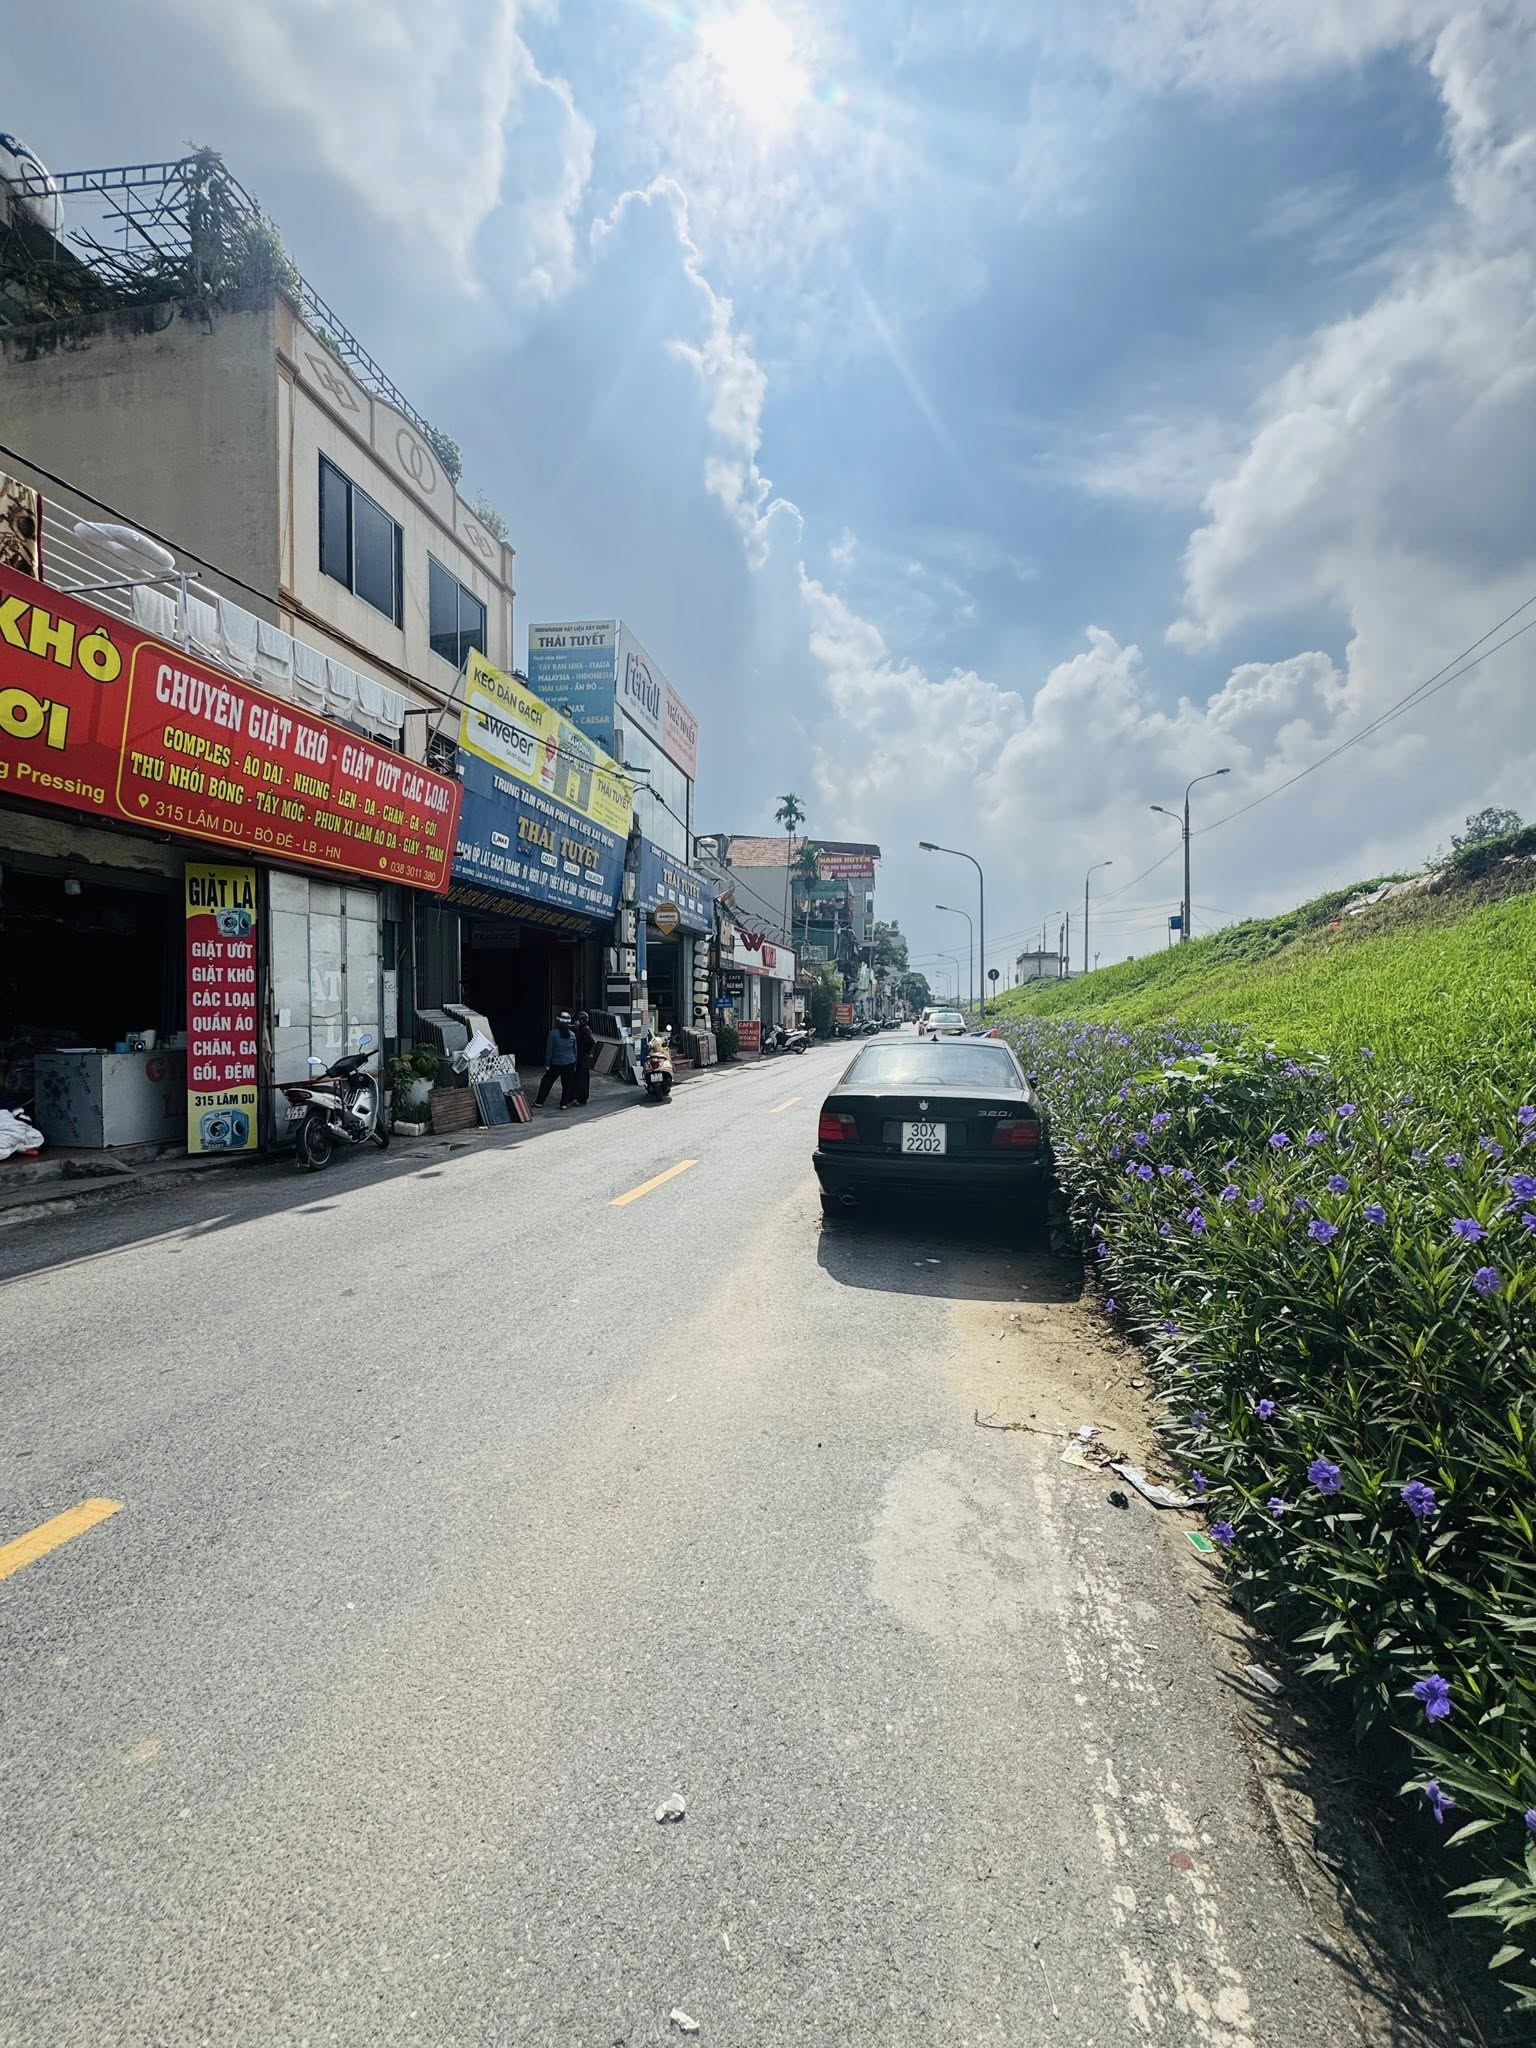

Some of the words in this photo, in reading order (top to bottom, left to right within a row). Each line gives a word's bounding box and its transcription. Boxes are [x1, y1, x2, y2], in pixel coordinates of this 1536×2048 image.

[538, 634, 566, 647] THÁI
[569, 632, 605, 647] TUYẾT
[589, 661, 610, 669] ITALIA
[538, 674, 570, 682] MALAYSIA
[576, 671, 614, 680] INDONESIA
[473, 667, 496, 692] KEO
[496, 685, 518, 709] DÁN
[518, 701, 543, 726] GẠCH
[156, 664, 244, 732] CHUYÊN
[248, 704, 293, 751] GIẶT
[294, 724, 329, 765] KHÔ
[341, 744, 375, 784] GIẶT
[402, 769, 424, 803] CÁC
[489, 715, 533, 757] weber
[16, 762, 105, 805] Pressing
[163, 725, 232, 768] COMPLES
[262, 760, 284, 785] DÀI
[293, 772, 330, 801] NHUNG
[338, 788, 358, 809] LEN
[364, 797, 376, 818] DẠ
[409, 815, 420, 831] GA
[493, 775, 520, 798] TRUNG
[131, 751, 165, 781] THÚ
[167, 763, 206, 793] NHỒI
[207, 776, 245, 805] BÔNG
[256, 788, 280, 815] TẨY
[281, 797, 305, 823] MỐC
[314, 809, 342, 833] PHUN
[342, 818, 354, 836] XI
[155, 801, 183, 821] 315
[187, 809, 220, 830] LÂM
[223, 819, 243, 835] DU
[302, 839, 317, 853] LB
[325, 845, 341, 860] HN
[560, 835, 600, 870] TUYẾT
[391, 861, 405, 874] 038
[405, 866, 422, 878] 3011
[424, 871, 436, 882] 380
[188, 872, 228, 914] GIẶT
[233, 874, 254, 909] LÀ
[191, 940, 224, 960] GIẶT
[227, 941, 253, 959] ƯỚT
[192, 964, 223, 985] GIẶT
[227, 965, 255, 983] KHÔ
[192, 989, 221, 1007] CÁC
[225, 992, 255, 1010] LOẠI
[192, 1011, 231, 1032] QUẦN
[235, 1013, 254, 1031] ÁO
[193, 1038, 235, 1057] CHĂN,
[239, 1041, 257, 1055] GA
[193, 1060, 221, 1081] GỐI,
[225, 1062, 255, 1082] ĐỆM
[195, 1095, 214, 1107] 315
[216, 1093, 239, 1105] LÂM
[241, 1093, 255, 1104] DU
[977, 1110, 1012, 1118] 320i
[911, 1123, 936, 1138] 30X
[907, 1138, 941, 1152] 2202
